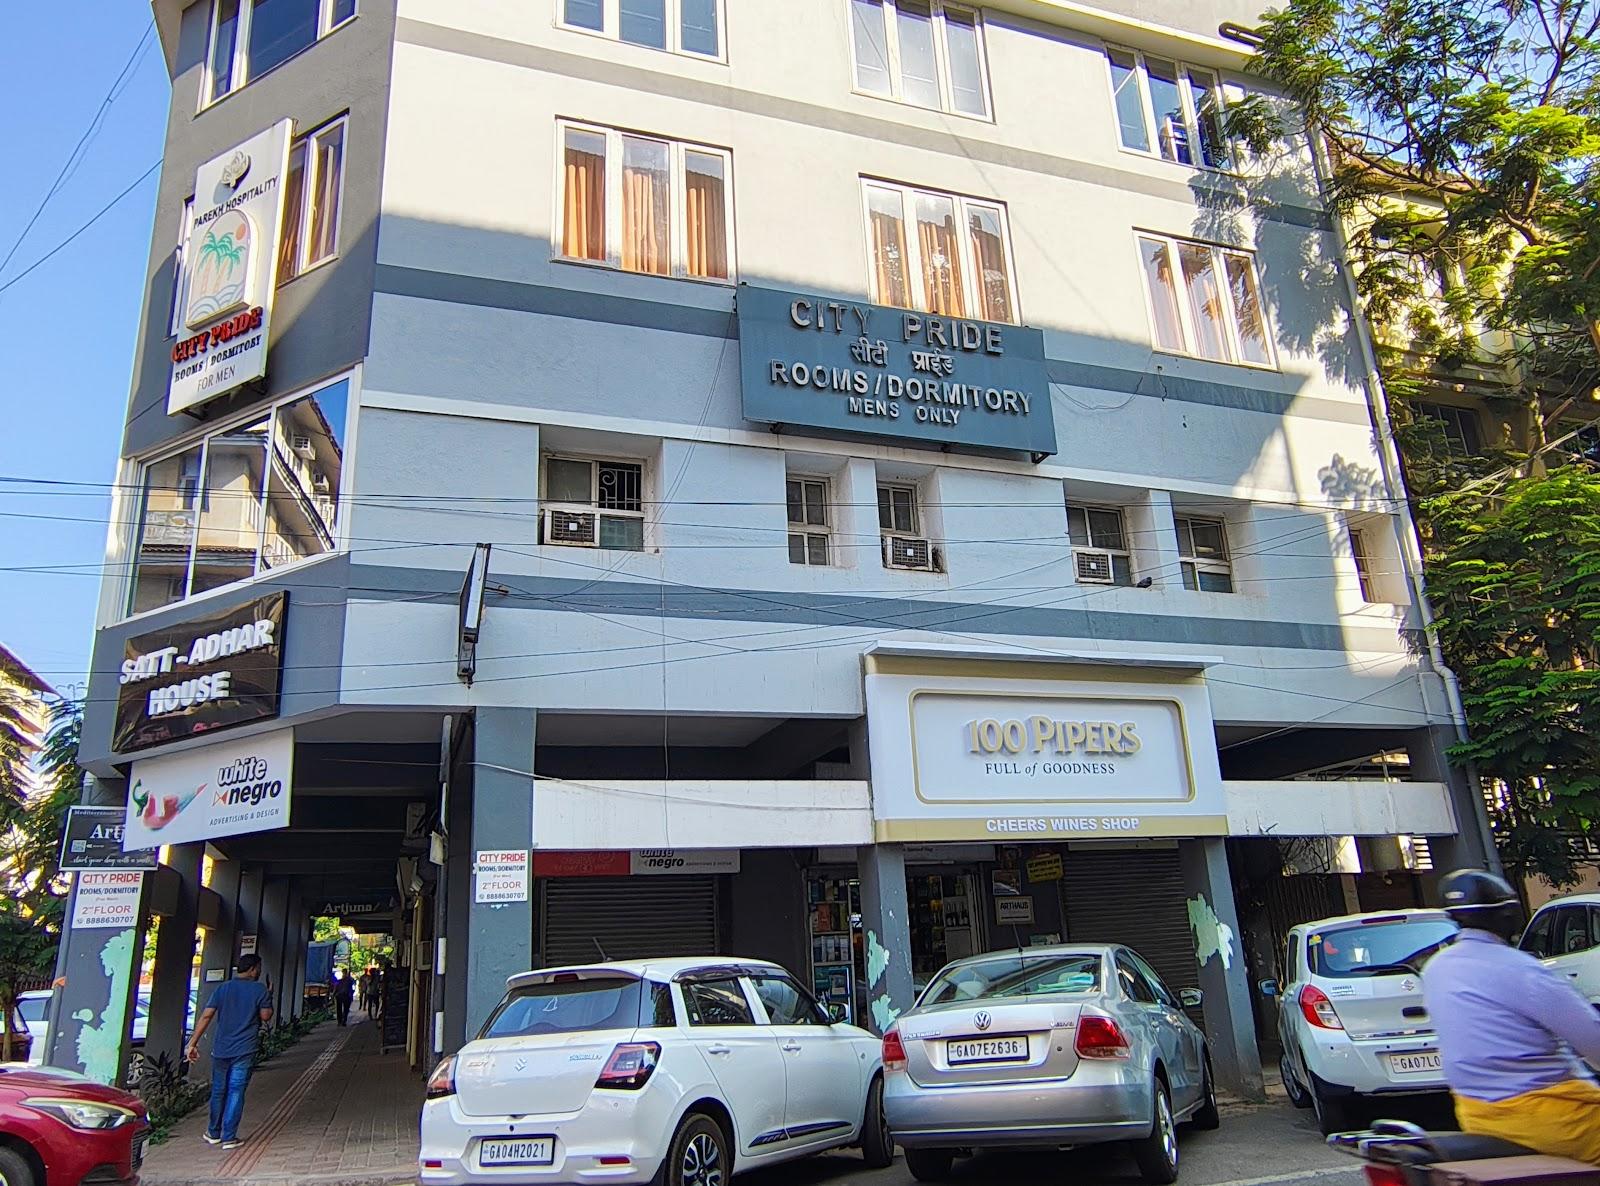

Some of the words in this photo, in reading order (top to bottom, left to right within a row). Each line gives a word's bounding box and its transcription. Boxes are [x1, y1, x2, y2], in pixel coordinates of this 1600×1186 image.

[193, 203, 224, 230] PAREKH
[225, 175, 279, 212] HOSPITALITY
[790, 297, 873, 336] CITY
[903, 312, 1005, 354] PRIDE
[172, 331, 210, 364] CITY
[210, 306, 263, 347] PRIDE
[850, 336, 889, 366] सीटी
[197, 375, 214, 392] FOR
[215, 365, 236, 383] MEN
[848, 396, 900, 418] MENS
[915, 405, 961, 426] ONLY
[147, 670, 231, 717] HOUSE
[967, 717, 1027, 754] 100
[1029, 715, 1142, 756] PIPERS
[217, 756, 267, 787] white
[985, 762, 1021, 775] FULL
[1025, 762, 1038, 777] of
[1043, 762, 1116, 776] GOODNESS
[228, 780, 282, 806] negro
[209, 813, 249, 826] ADVERTISING
[256, 808, 280, 818] DESIGN
[986, 818, 1047, 833] CHEERS
[1050, 817, 1098, 832] WINES
[1101, 816, 1141, 831] SHOP
[90, 823, 126, 842] Artj
[479, 853, 500, 863] CITY
[500, 853, 526, 862] PRIDE
[648, 858, 684, 868] negro
[82, 873, 108, 884] CITY
[108, 872, 141, 883] PRIDE
[492, 881, 521, 889] FLOOR
[94, 905, 131, 914] FLOOR
[86, 916, 134, 925] 8888630707
[956, 1041, 1018, 1057] GA07E2636
[1400, 1056, 1440, 1069] GA07L0
[489, 1143, 545, 1160] GA04H2021
